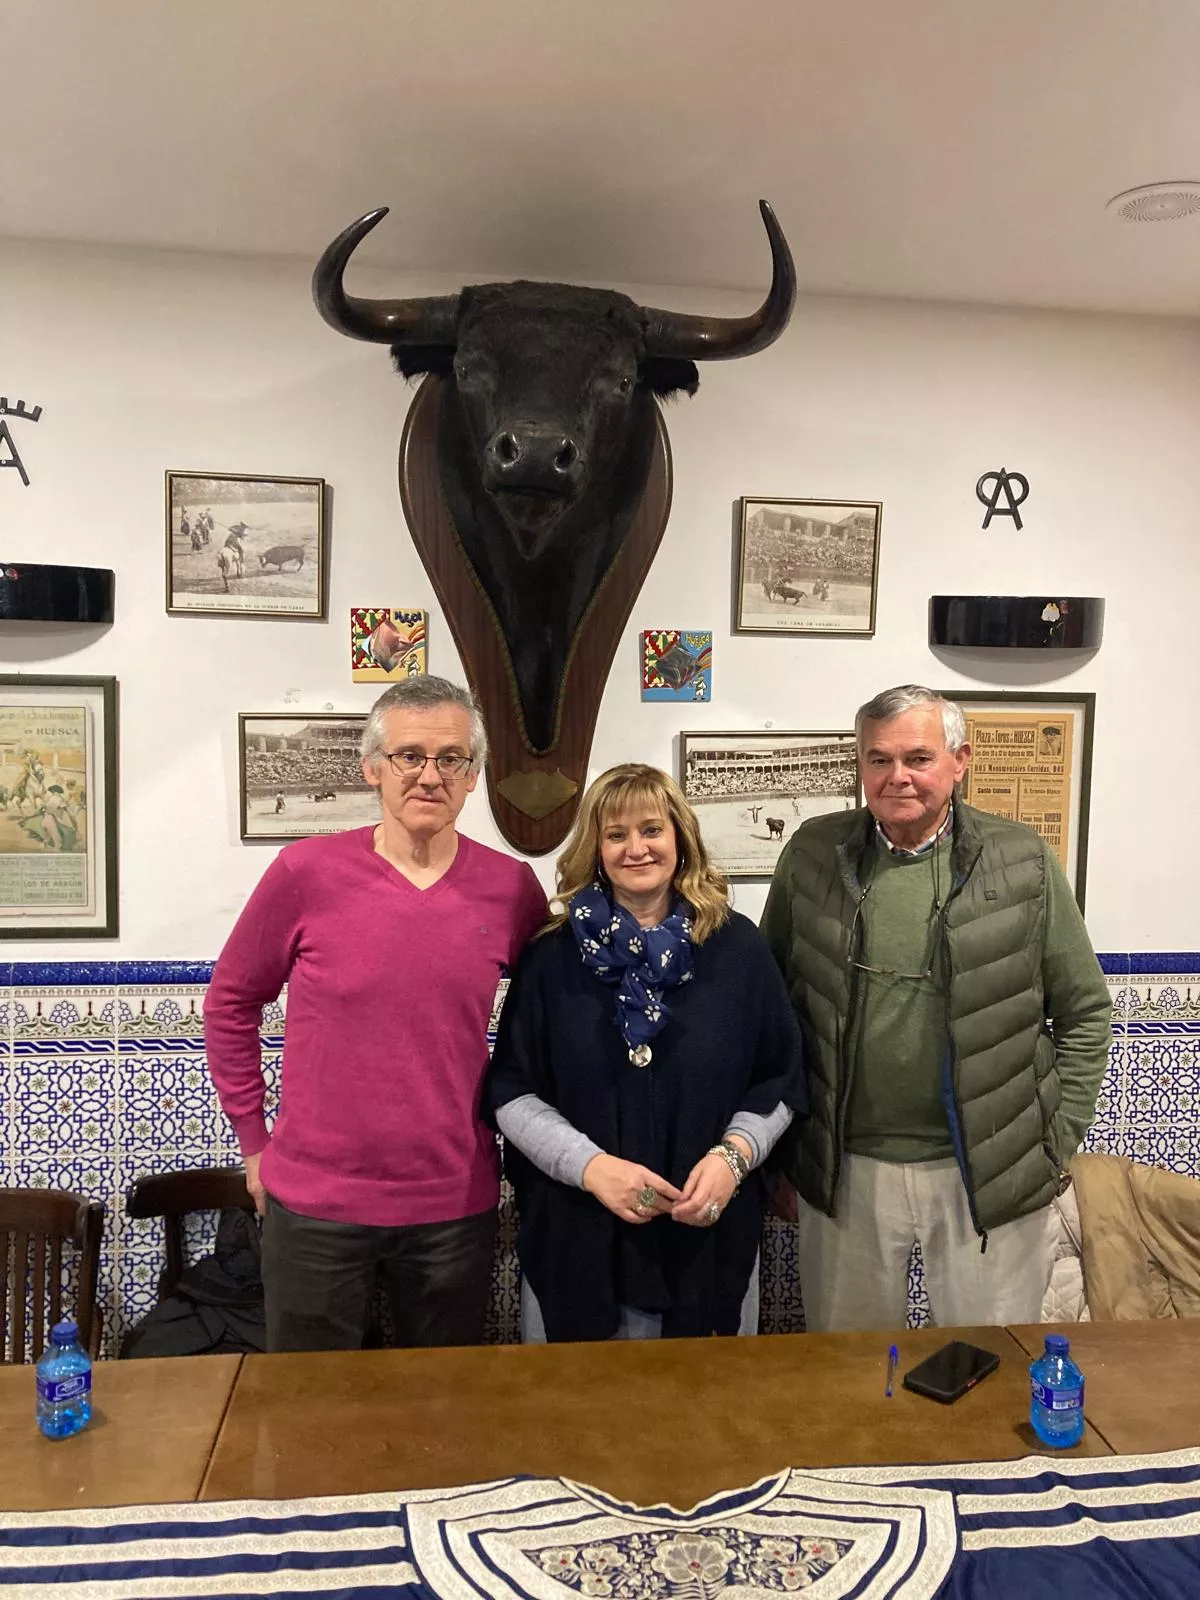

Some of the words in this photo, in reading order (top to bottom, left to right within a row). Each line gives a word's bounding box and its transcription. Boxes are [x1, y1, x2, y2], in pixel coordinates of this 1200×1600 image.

[36, 727, 79, 735] HUESCA
[976, 730, 991, 743] Plaza
[1014, 731, 1035, 743] HUESCA
